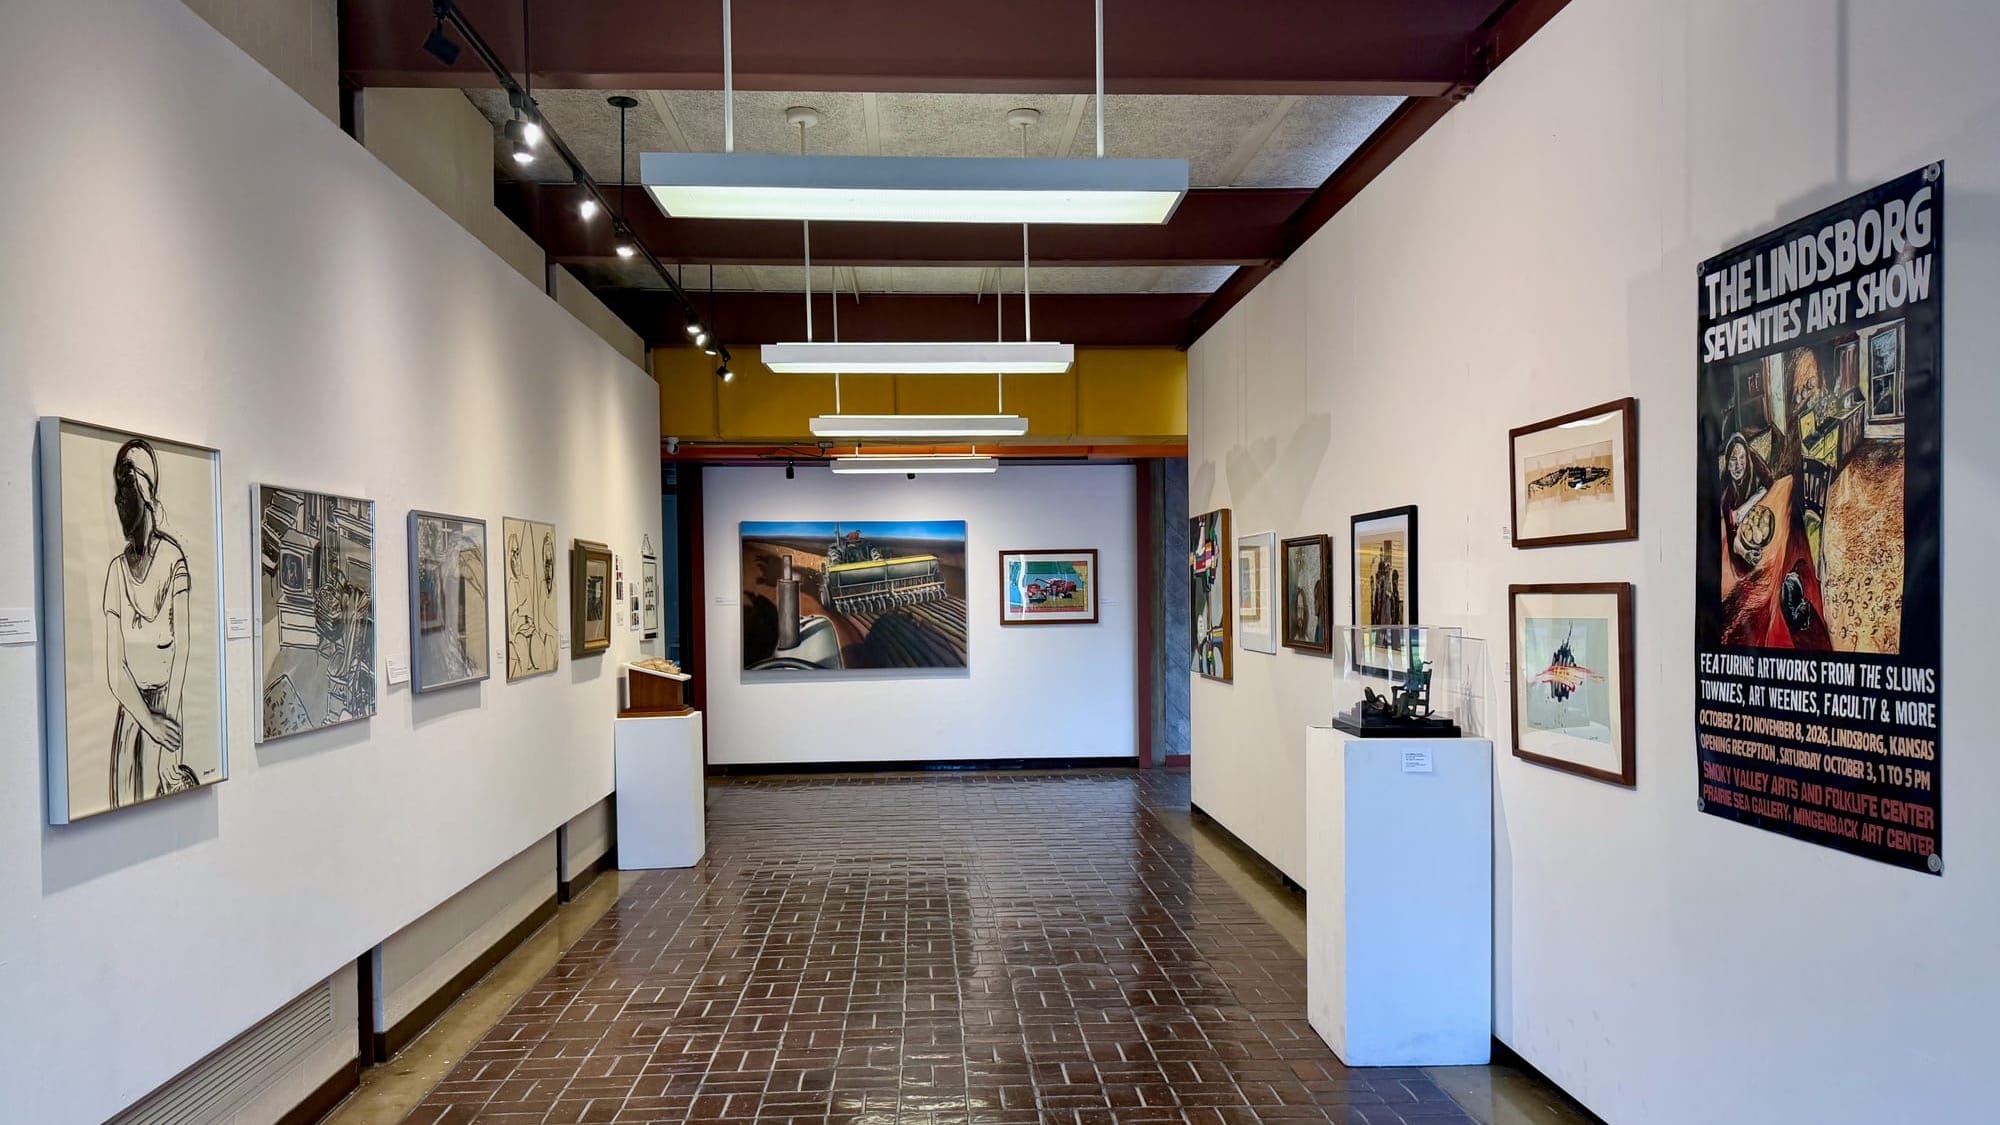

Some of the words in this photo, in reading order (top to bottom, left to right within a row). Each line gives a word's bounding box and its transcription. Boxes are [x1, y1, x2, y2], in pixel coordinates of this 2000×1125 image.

[1705, 259, 1751, 320] THE
[1755, 186, 1931, 303] LINDSBORG
[1703, 298, 1801, 363] SEVENTIES
[1807, 281, 1850, 334] ART
[1856, 254, 1931, 319] SHOW
[1700, 653, 1754, 677] FEATURING
[1757, 657, 1817, 683] ARTWORKS
[1821, 661, 1855, 687] FROM
[1860, 664, 1882, 689] THE
[1885, 666, 1935, 693] SLUMS
[1700, 680, 1745, 707] TOWNIES,
[1749, 685, 1766, 707] ART
[1769, 687, 1820, 717] WEENIES,
[1824, 693, 1876, 720] FACULTY
[1880, 699, 1890, 723] &
[1895, 700, 1936, 728] MORE
[1700, 709, 1733, 729] OCTOBER
[1734, 714, 1740, 731] 2
[1742, 715, 1753, 732] TO
[1753, 716, 1794, 740] NOVEMBER
[1795, 722, 1804, 743] 8,
[1805, 724, 1830, 747] 2026,
[1831, 728, 1887, 756] LINDSBORG,
[1889, 736, 1935, 760] KANSAS
[1700, 733, 1731, 754] OPENING
[1780, 747, 1821, 771] SATURDAY
[1824, 755, 1864, 779] OCTOBER
[1866, 762, 1876, 783] 3,
[1879, 764, 1885, 783] 1
[1886, 765, 1902, 785] TO
[1905, 768, 1913, 788] 5
[1914, 769, 1930, 791] PM
[1703, 761, 1731, 784] SMOKY
[1733, 767, 1769, 792] VALLEY
[1771, 776, 1798, 799] ARTS
[1801, 782, 1822, 805] AND
[1825, 787, 1877, 817] FOLKLIFE
[1881, 798, 1934, 830] CENTER
[1703, 784, 1732, 807] PRAIRIE
[1733, 791, 1750, 812] SEA
[1752, 797, 1791, 821] GALLERY,
[1793, 806, 1858, 839] MINGENBACK
[1861, 823, 1883, 845] ART
[1887, 828, 1934, 856] CENTER
